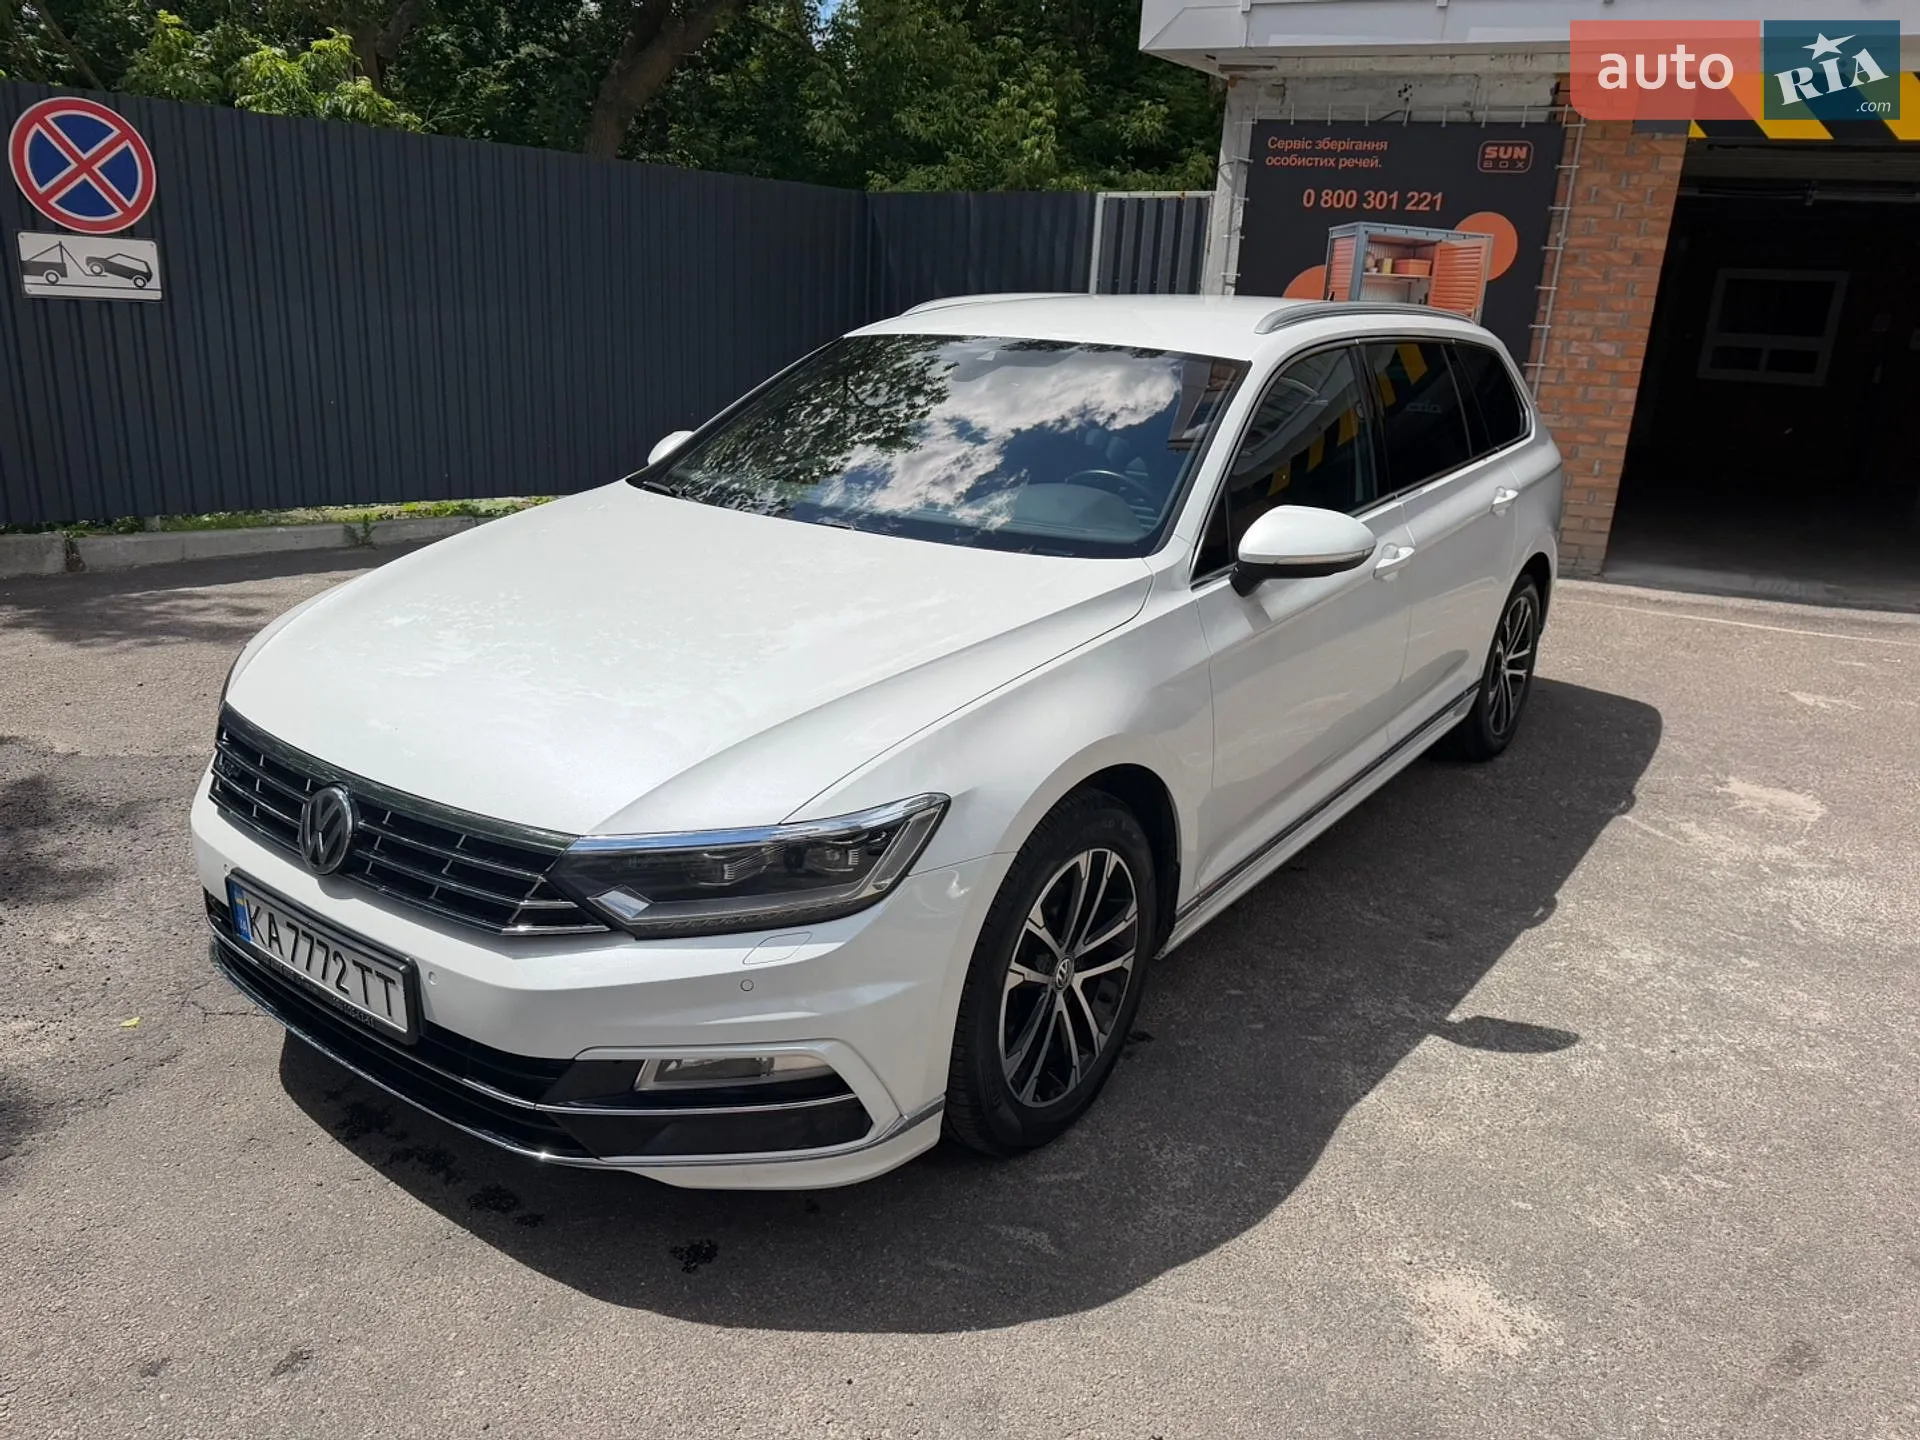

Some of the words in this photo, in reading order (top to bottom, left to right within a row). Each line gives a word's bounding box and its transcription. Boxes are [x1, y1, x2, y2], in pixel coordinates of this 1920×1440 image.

[1267, 136, 1313, 152] Сервіс
[1315, 137, 1389, 153] зберігання
[1484, 146, 1528, 160] SUN
[1265, 154, 1337, 167] особистих
[1338, 155, 1383, 170] речей.
[1482, 160, 1525, 169] BOX
[1303, 188, 1316, 208] 0
[1320, 189, 1358, 209] 800
[1362, 190, 1400, 211] 301
[1404, 191, 1444, 212] 221
